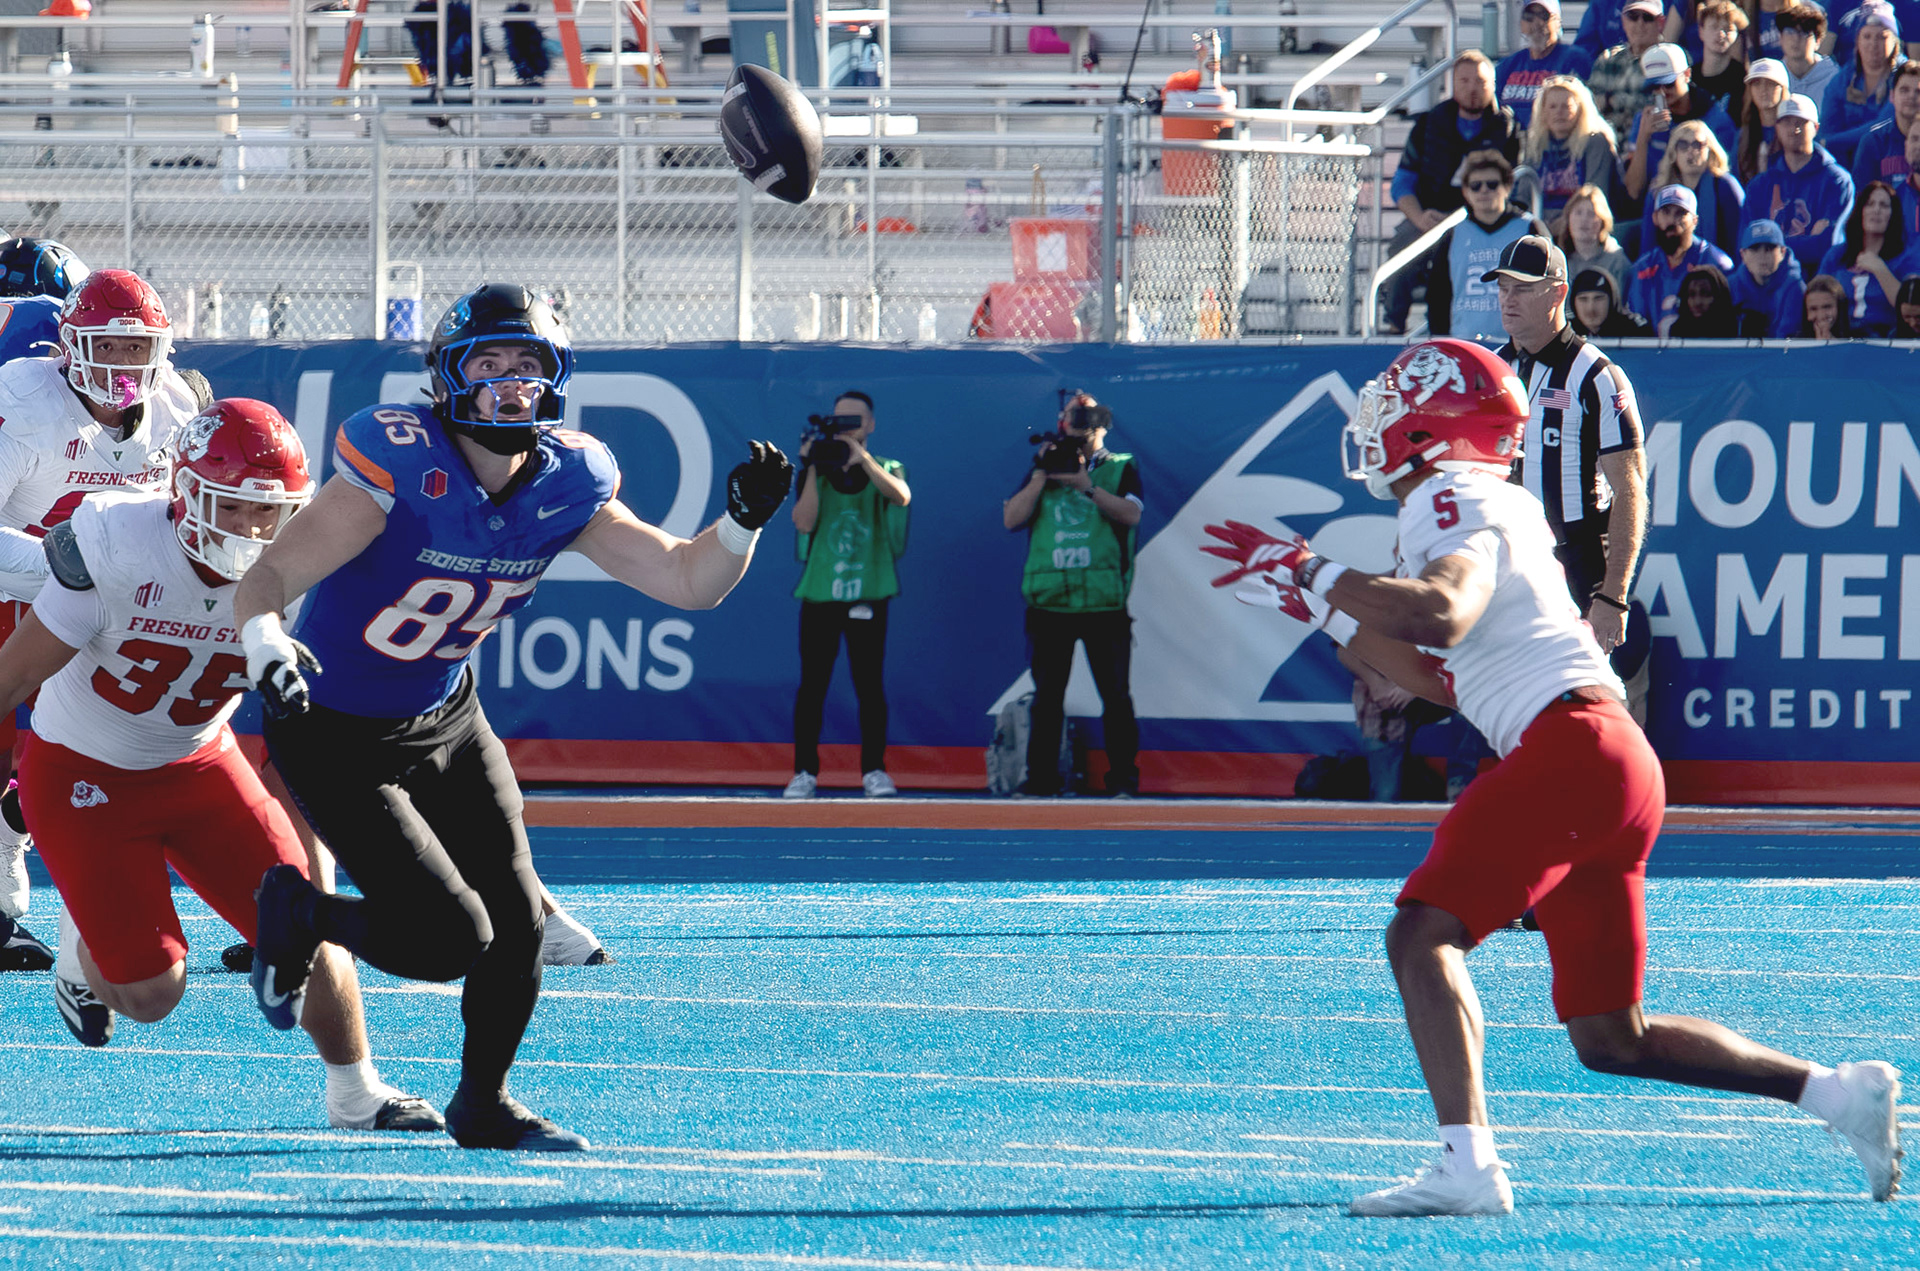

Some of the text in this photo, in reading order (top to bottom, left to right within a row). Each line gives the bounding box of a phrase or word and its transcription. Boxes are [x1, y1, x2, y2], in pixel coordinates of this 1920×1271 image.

[1456, 298, 1502, 311] CAROLI
[373, 409, 432, 449] 85
[1543, 427, 1560, 447] C
[1432, 488, 1461, 530] 5
[416, 548, 488, 573] BOISE
[487, 556, 551, 576] STATE
[1052, 546, 1091, 569] 029
[1634, 553, 1920, 661] AME
[127, 616, 212, 640] FRESNO
[363, 577, 542, 663] 85
[1683, 688, 1912, 730] CREDIT
